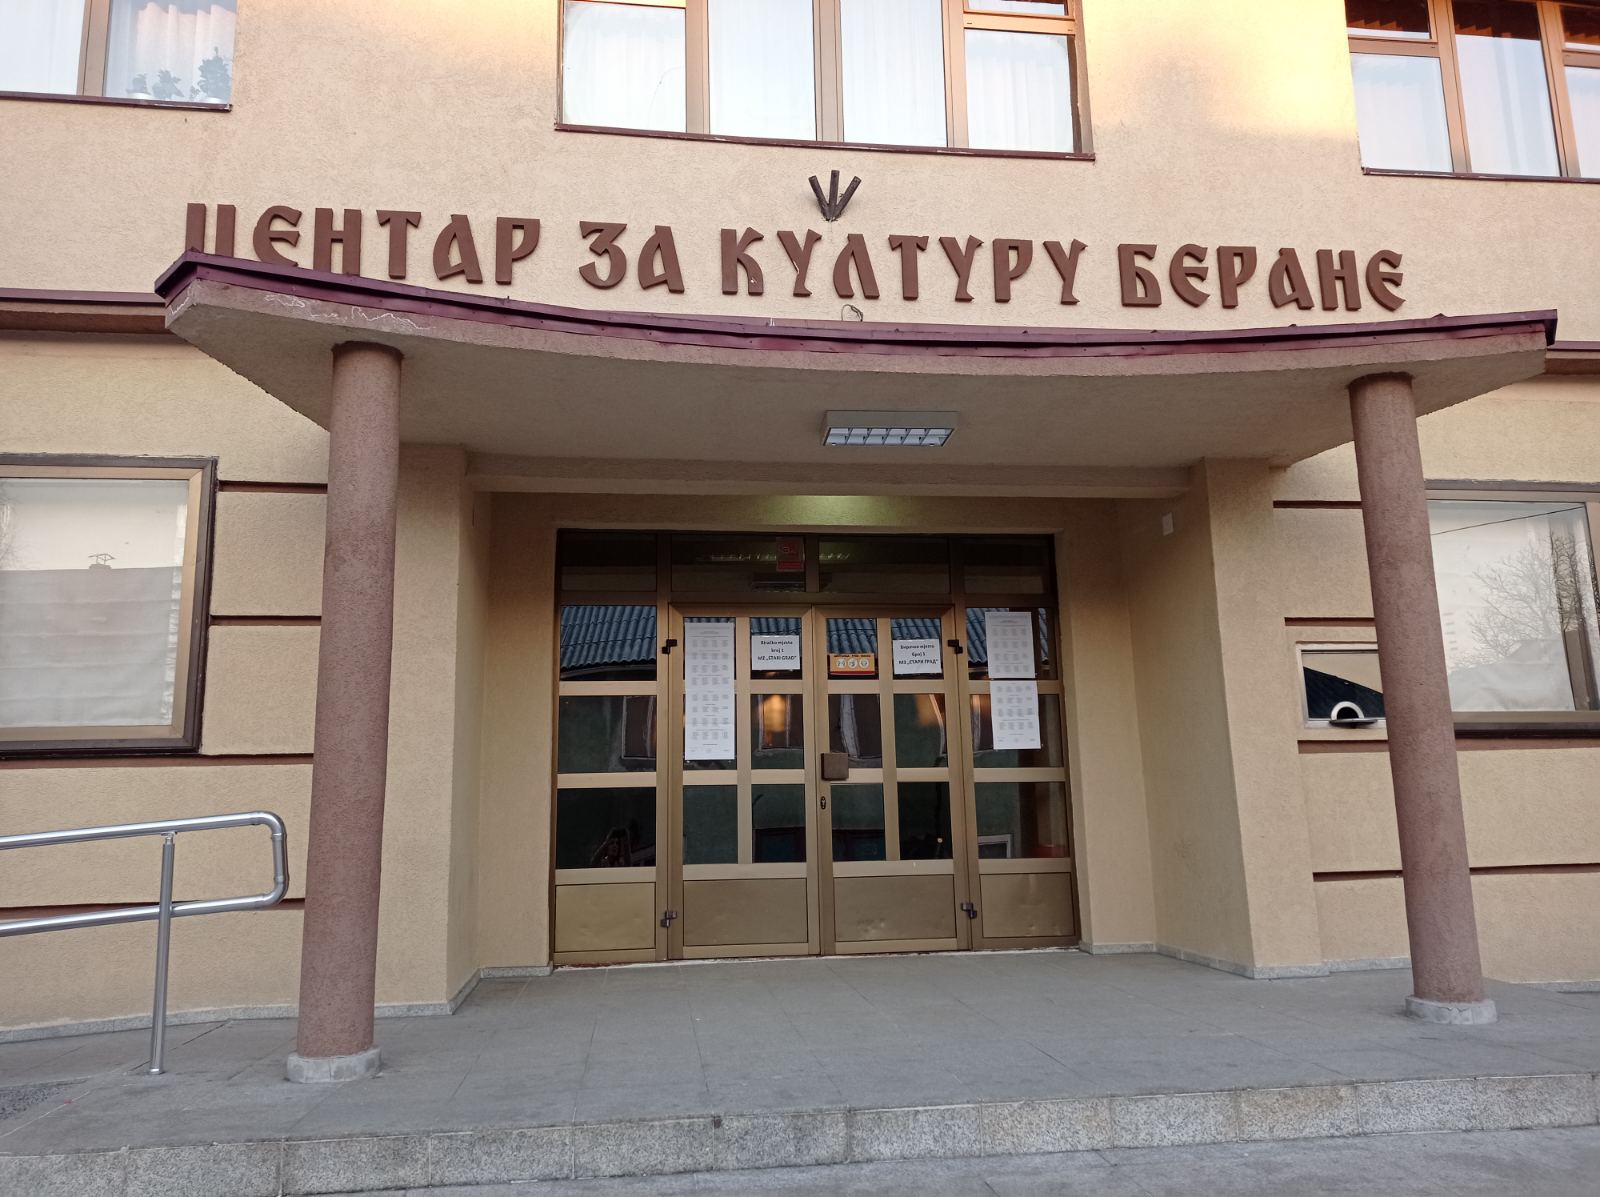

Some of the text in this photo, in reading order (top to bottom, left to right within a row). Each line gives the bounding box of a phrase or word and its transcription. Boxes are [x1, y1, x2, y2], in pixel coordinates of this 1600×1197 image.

[579, 221, 686, 293] ЗА
[720, 226, 1088, 305] КУЛТУРУ
[1117, 243, 1406, 311] БЕРАНЕ
